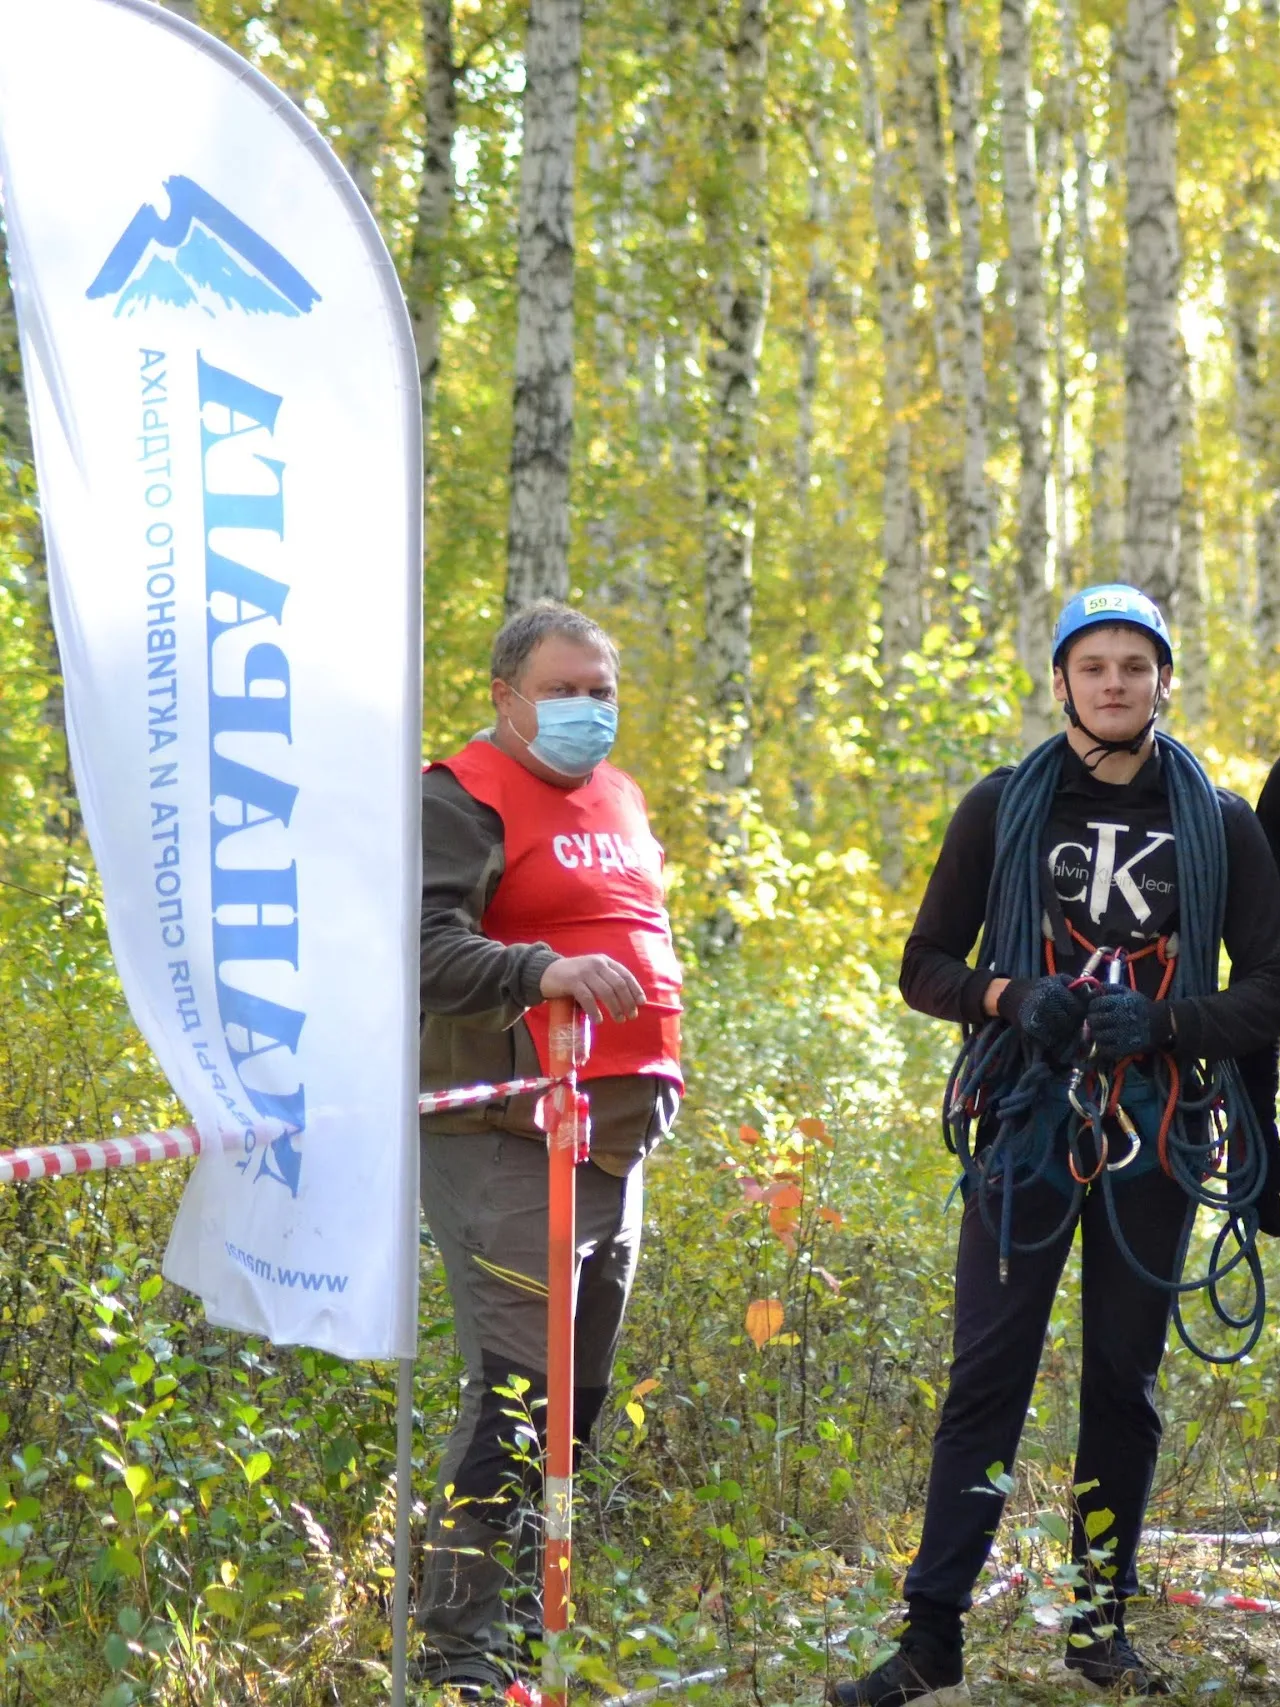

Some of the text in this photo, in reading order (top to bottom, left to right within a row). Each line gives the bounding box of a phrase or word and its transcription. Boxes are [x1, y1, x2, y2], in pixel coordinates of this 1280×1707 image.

[1089, 596, 1123, 610] 59.2
[552, 832, 656, 875] СУДЬ
[1052, 859, 1090, 881] alvin
